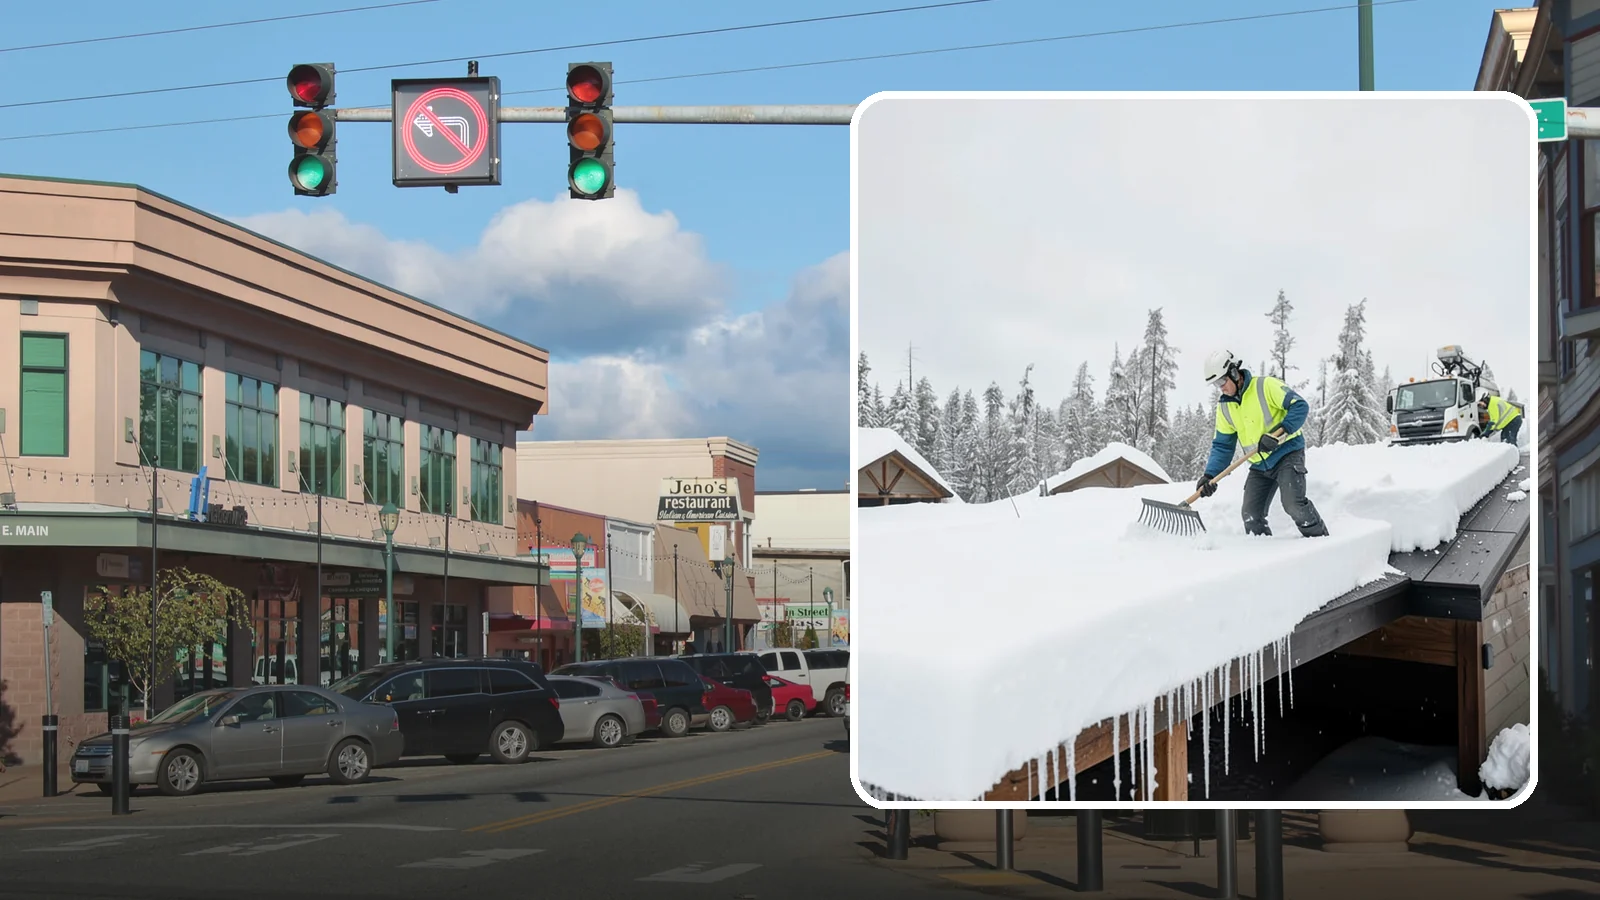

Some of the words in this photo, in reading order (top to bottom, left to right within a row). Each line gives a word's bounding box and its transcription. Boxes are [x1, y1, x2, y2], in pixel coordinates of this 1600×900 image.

[670, 480, 727, 494] Jeno's
[665, 496, 731, 509] restaurant
[659, 510, 682, 519] Italian
[685, 510, 714, 519] American
[715, 509, 737, 519] Cuisine
[2, 525, 13, 536] E.
[15, 525, 49, 536] MAIN
[786, 607, 795, 617] in
[797, 607, 829, 617] Street
[791, 619, 823, 627] lass
